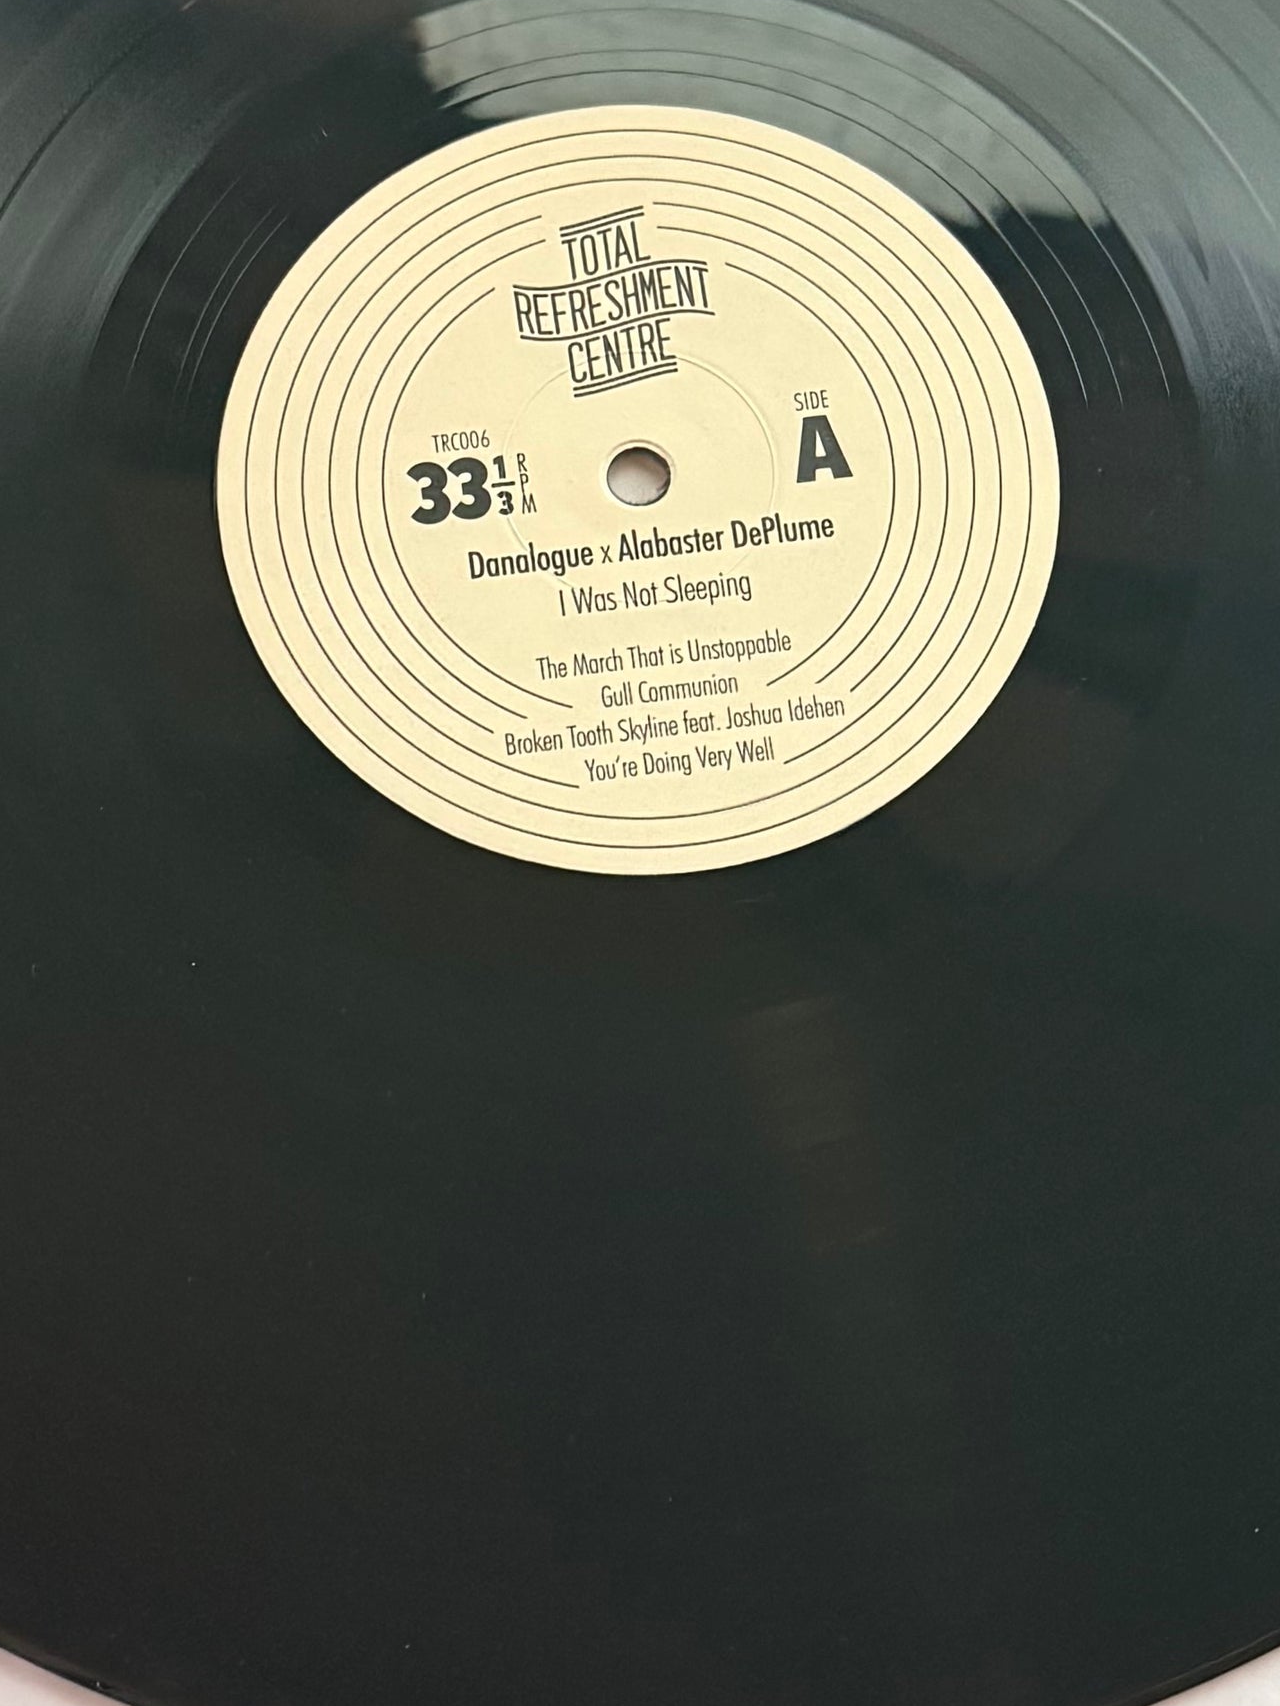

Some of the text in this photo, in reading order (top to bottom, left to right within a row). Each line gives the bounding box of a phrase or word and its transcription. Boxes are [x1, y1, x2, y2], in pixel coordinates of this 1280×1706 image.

[561, 221, 651, 280] TOTAL
[513, 266, 709, 334] REFRESHMENT
[568, 317, 677, 383] CENTRE
[793, 389, 829, 411] SIDE
[431, 429, 490, 453] TRC006
[796, 415, 853, 483] A
[468, 512, 835, 579] Danalogue x Alabaster DePlume
[559, 572, 752, 616] I Was Not Sleeping
[536, 628, 792, 680] The March That is Unstoppable
[601, 673, 738, 708] Gull Communion
[505, 694, 845, 755] Broken Tooth Skyline feat. Joshua Idehen
[585, 736, 775, 782] You're Doing Very Well
